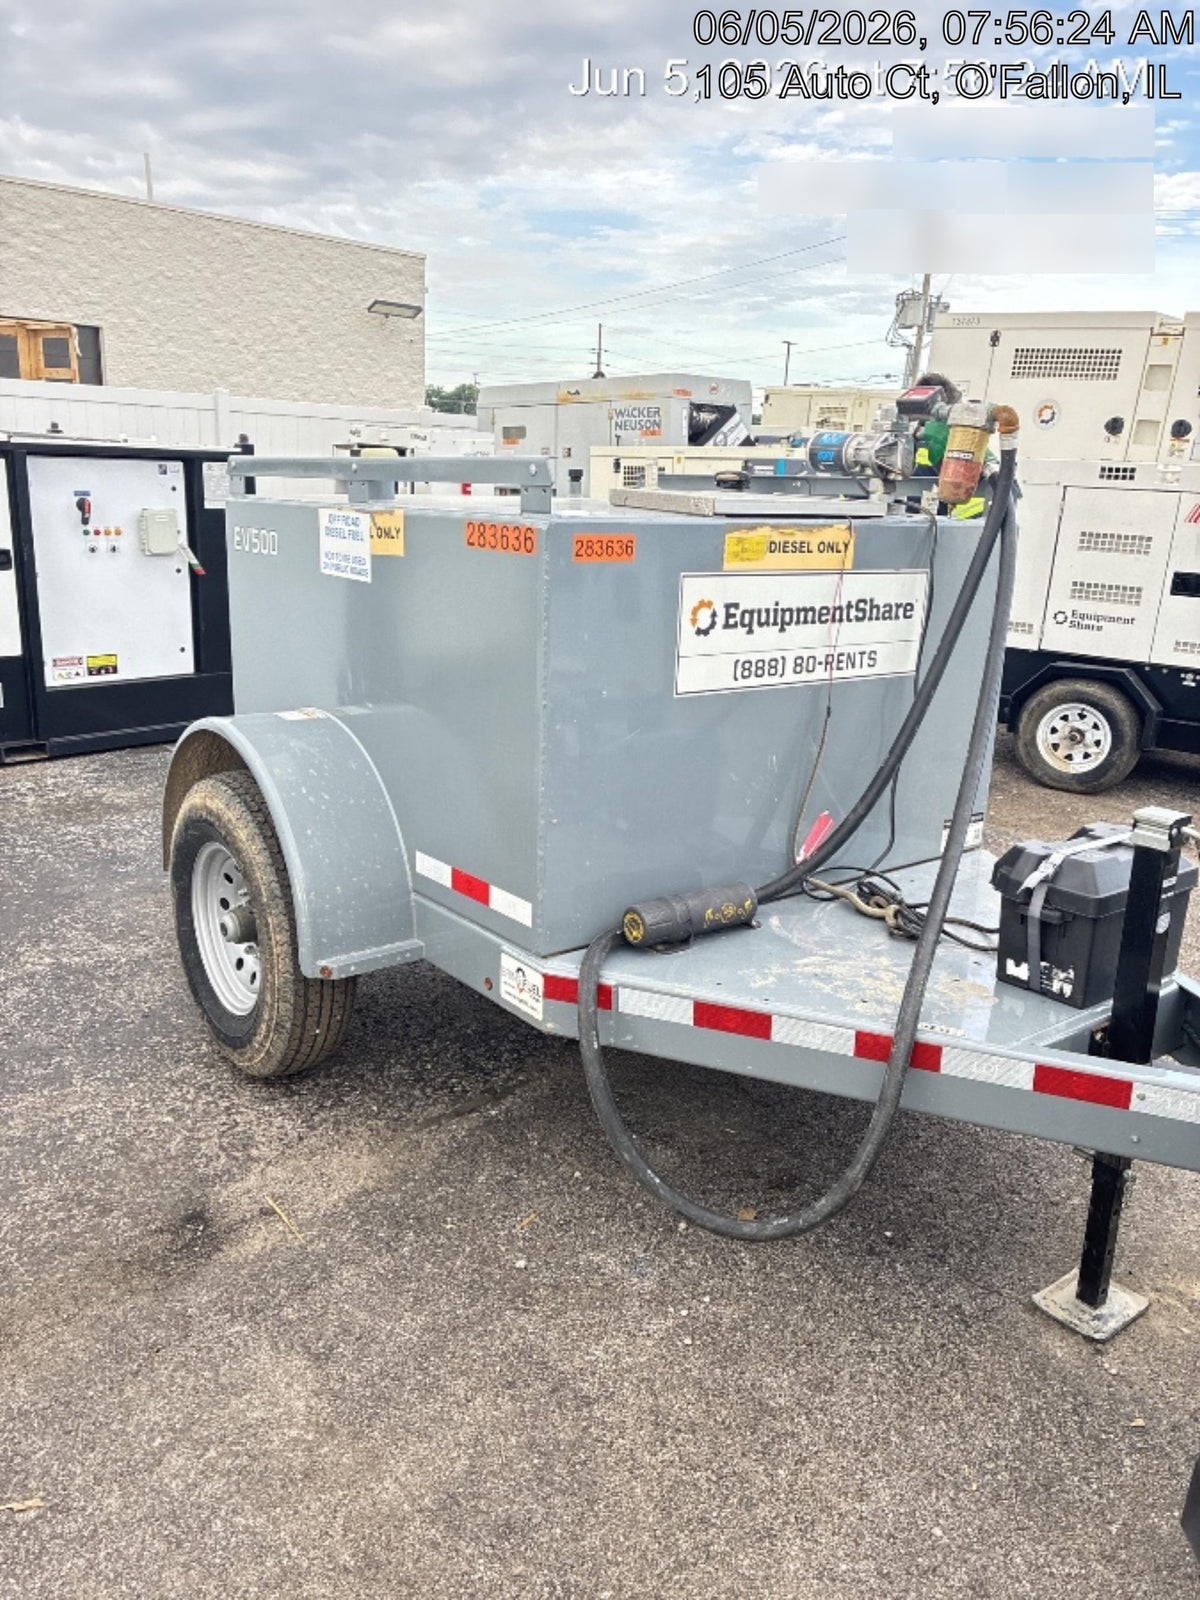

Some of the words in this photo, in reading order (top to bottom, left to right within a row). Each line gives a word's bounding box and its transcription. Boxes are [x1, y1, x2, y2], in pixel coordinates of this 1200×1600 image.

[614, 405, 661, 419] WACKER
[614, 419, 661, 431] NEUSON
[233, 526, 278, 555] EV500
[376, 526, 401, 540] ONLY
[466, 521, 535, 554] 283636
[574, 539, 634, 558] 283636
[769, 540, 813, 554] DIESEL
[817, 540, 850, 554] ONLY
[721, 597, 915, 636] EquipmentShare
[1068, 619, 1104, 632] Share
[1070, 608, 1136, 626] Equipment
[733, 655, 787, 682] (888)
[792, 650, 878, 675] 80-RENTS
